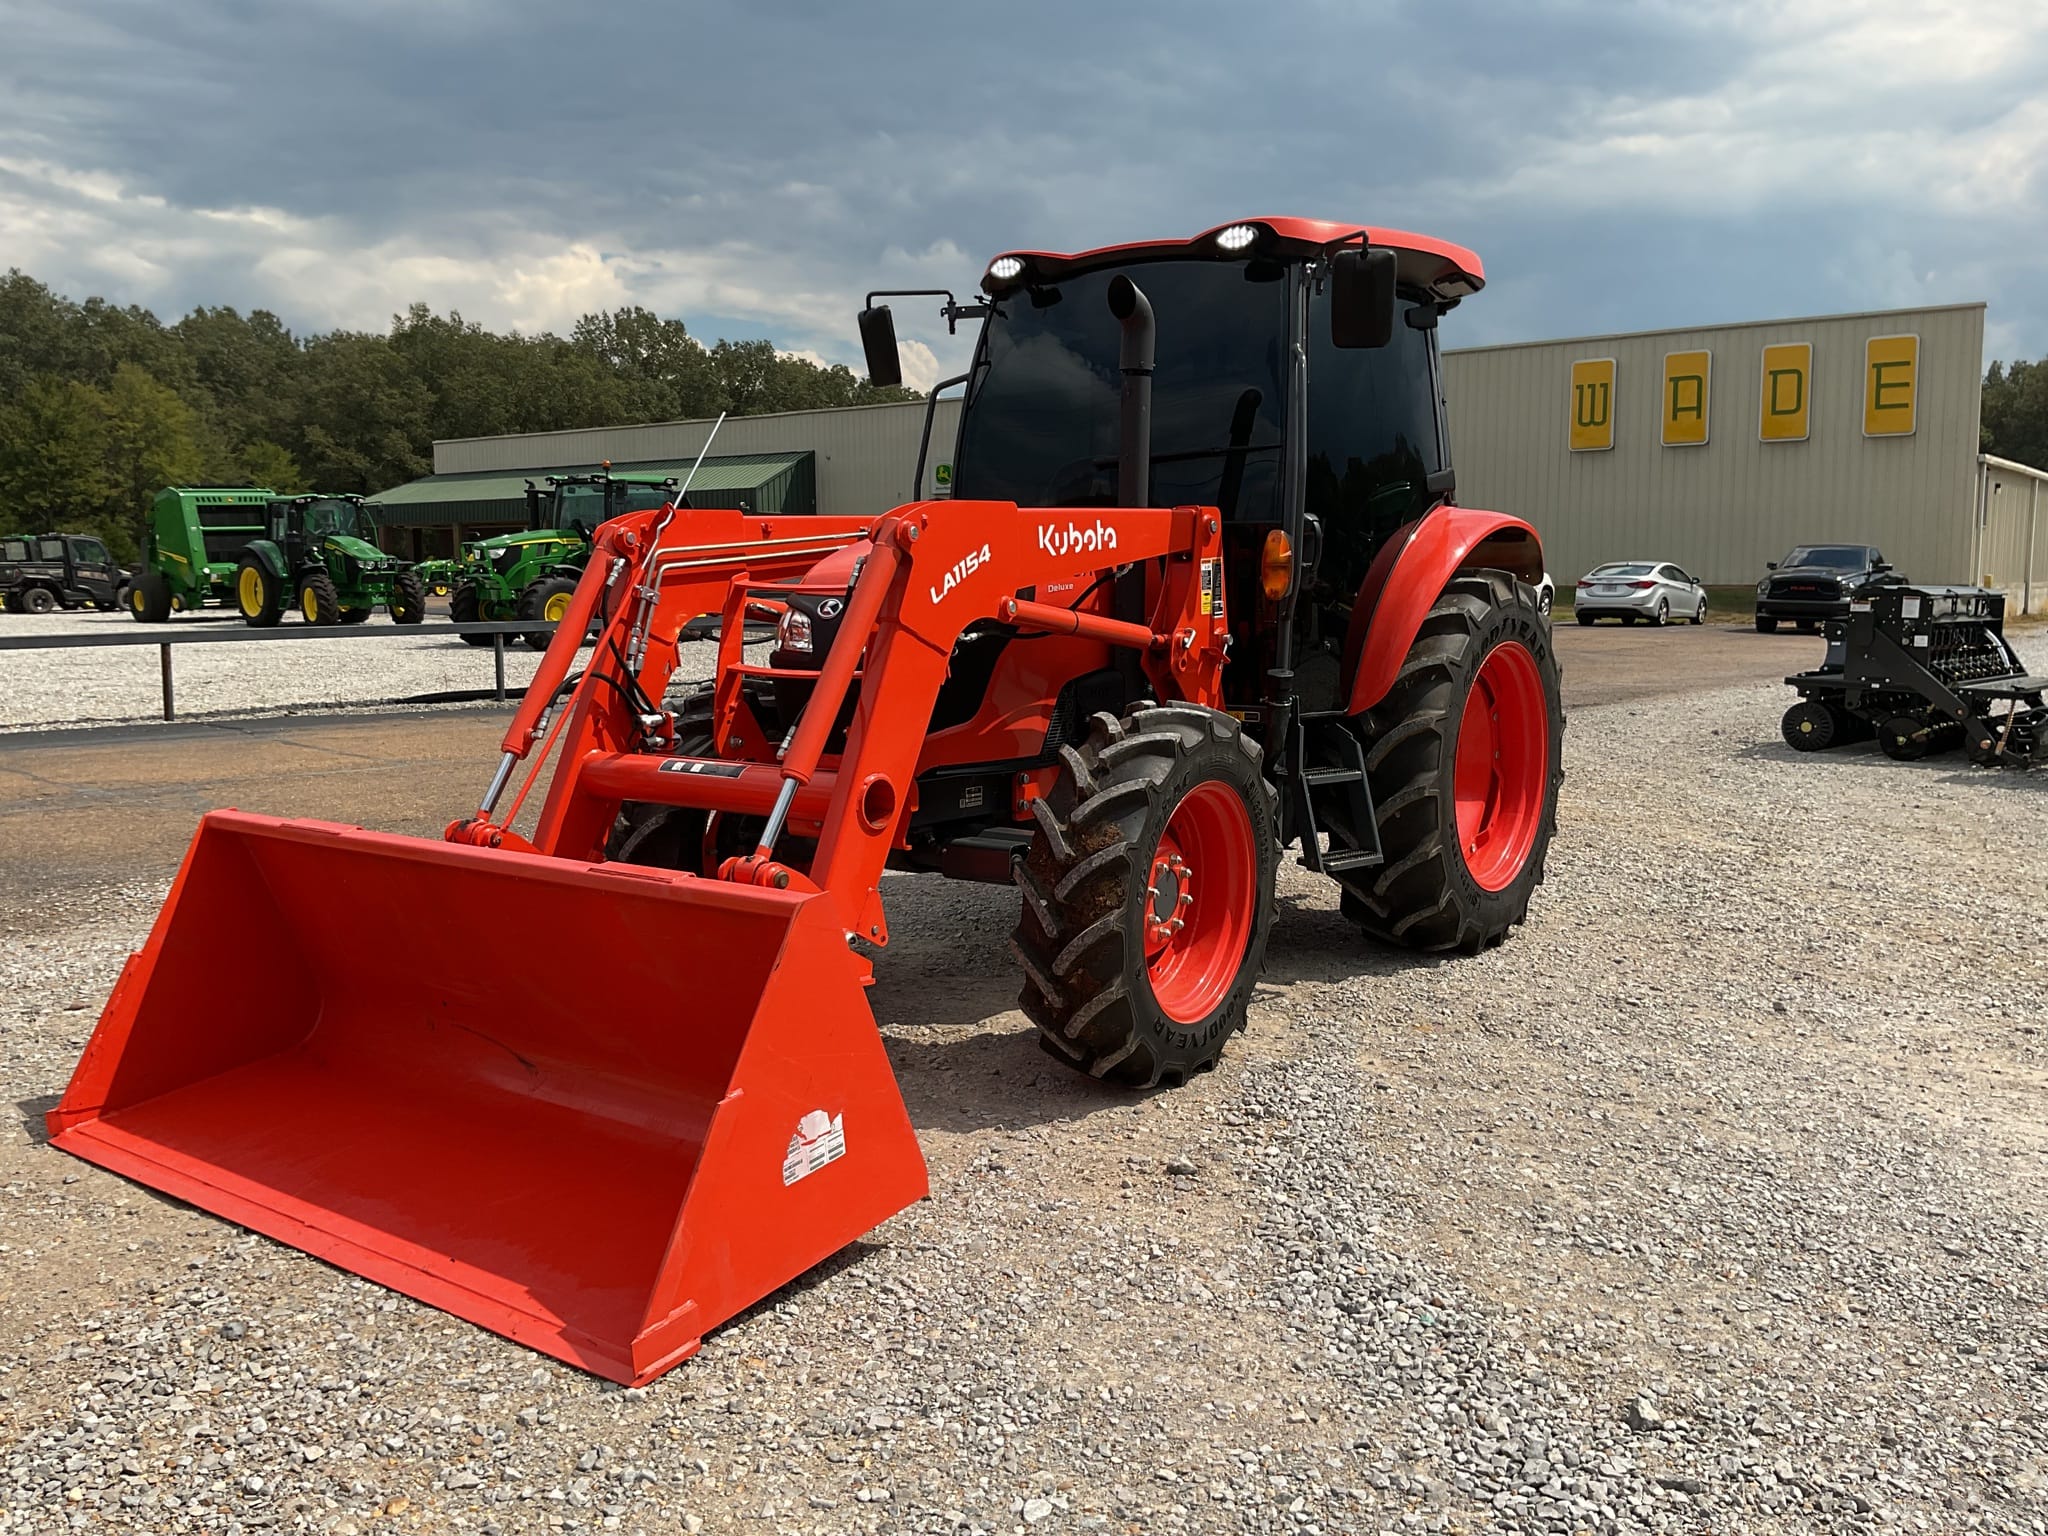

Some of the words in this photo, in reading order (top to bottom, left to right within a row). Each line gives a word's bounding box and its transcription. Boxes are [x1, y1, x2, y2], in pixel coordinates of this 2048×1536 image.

[1038, 520, 1117, 556] Kubota
[930, 543, 991, 604] LA1154
[1048, 583, 1074, 593] Deluxe
